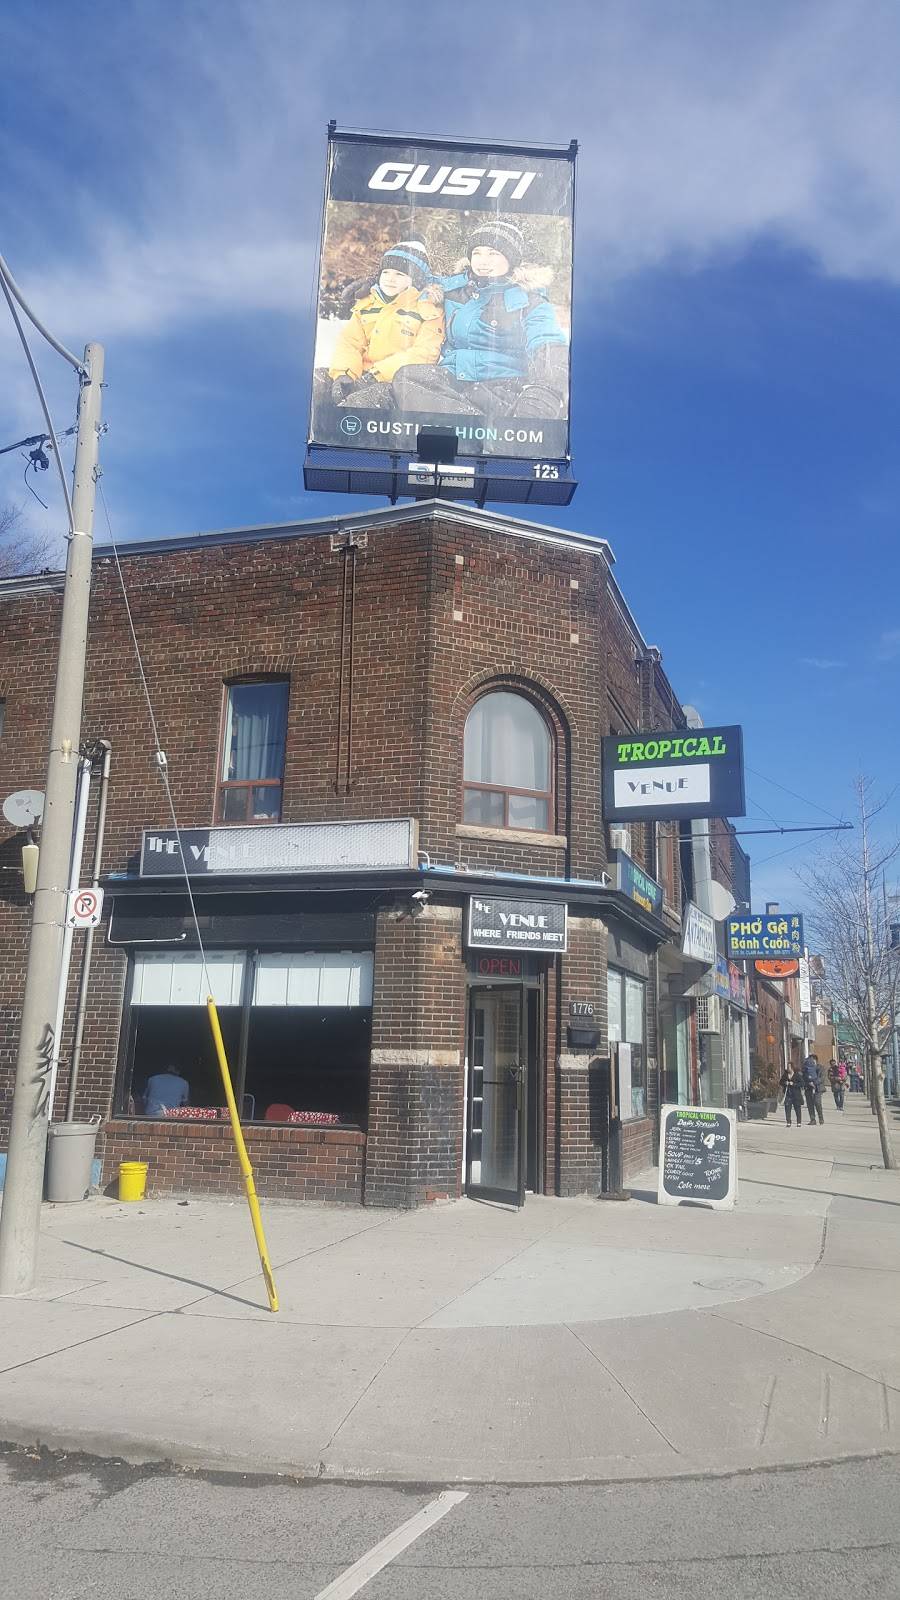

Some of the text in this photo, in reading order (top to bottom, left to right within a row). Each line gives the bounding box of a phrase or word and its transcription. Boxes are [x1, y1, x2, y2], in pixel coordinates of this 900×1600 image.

[367, 162, 537, 200] GUSTI
[366, 420, 544, 443] GUSTIHION.COM
[617, 736, 726, 763] TROPICAL
[627, 777, 689, 795] VENUE
[147, 836, 179, 854] THE
[474, 900, 491, 914] THE
[499, 912, 548, 929] VENUE
[767, 917, 788, 935] GÀ
[473, 928, 564, 942] WHERE FRIENDS MEET
[731, 936, 760, 950] Bánh
[479, 959, 520, 976] OPEN
[573, 1002, 594, 1014] 1776
